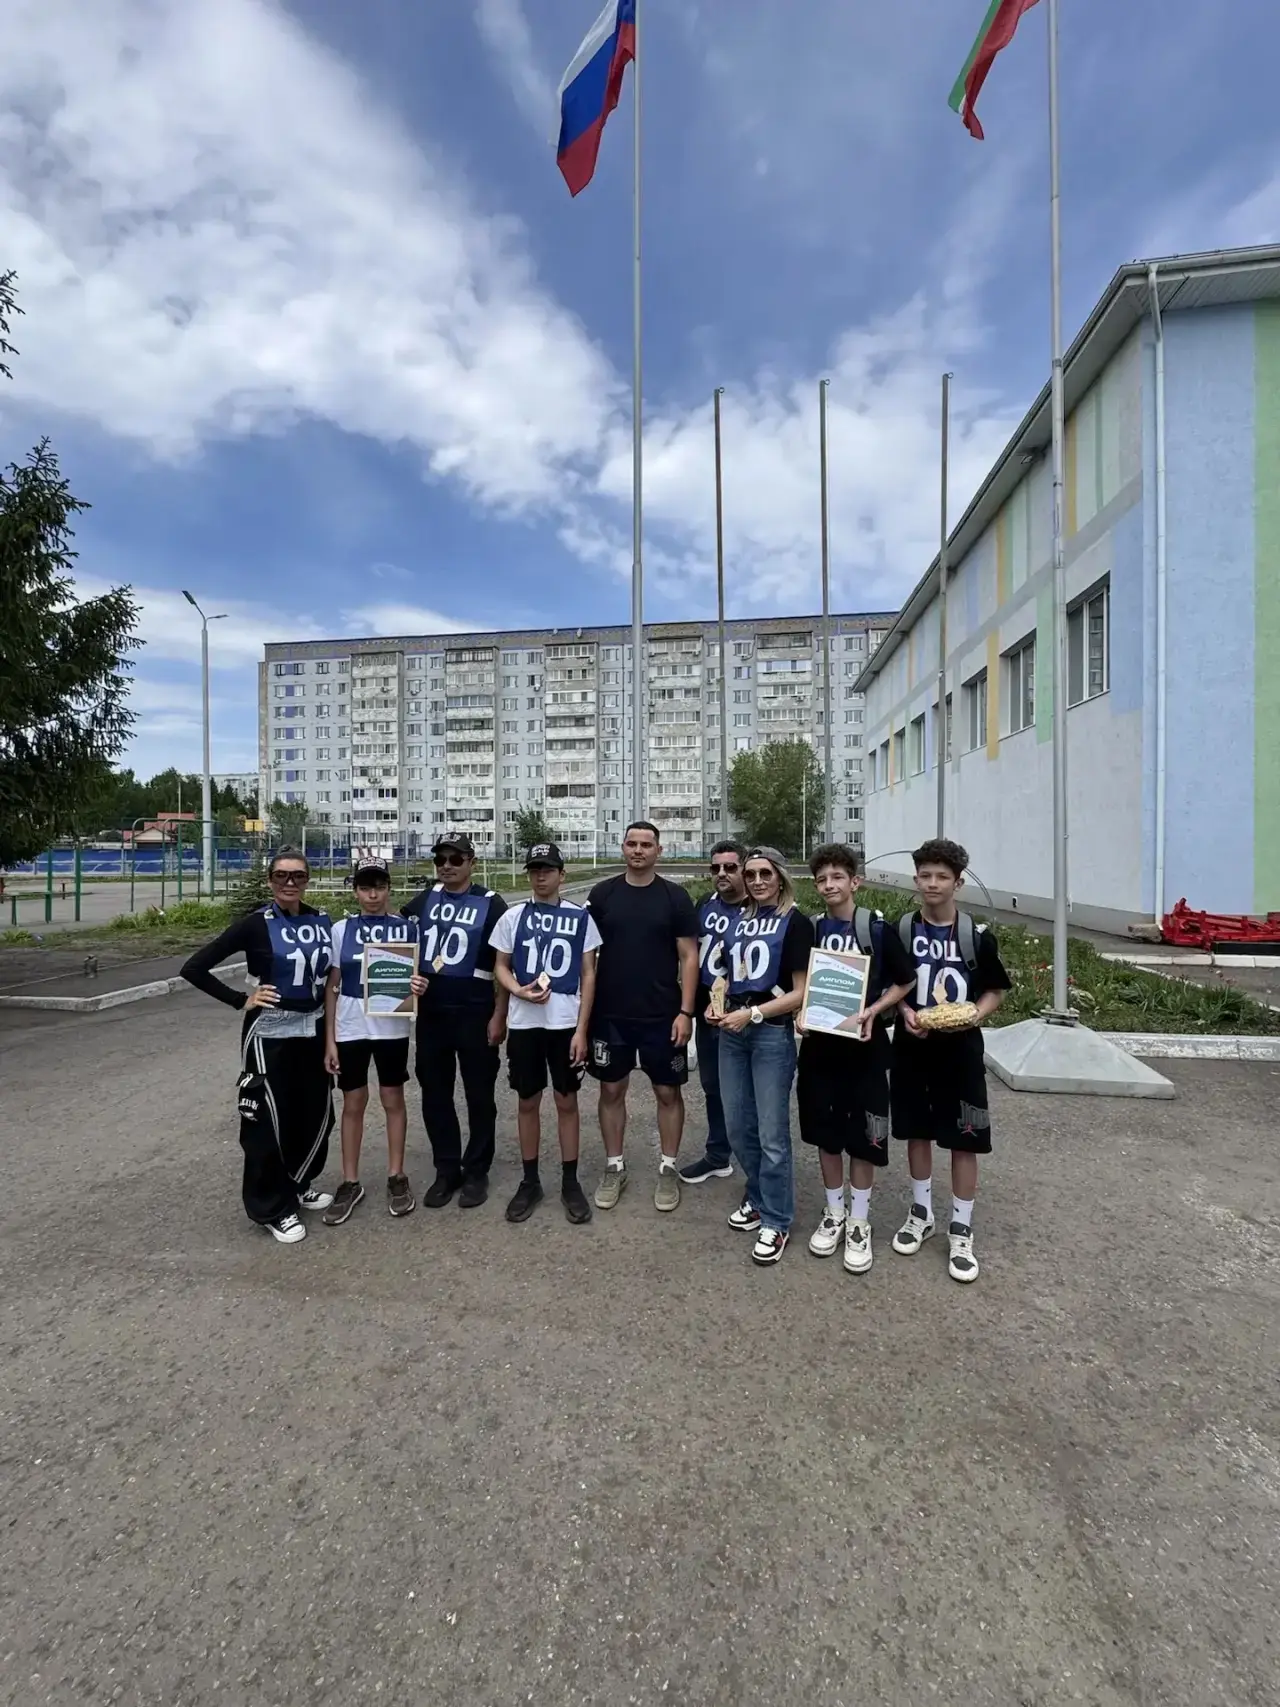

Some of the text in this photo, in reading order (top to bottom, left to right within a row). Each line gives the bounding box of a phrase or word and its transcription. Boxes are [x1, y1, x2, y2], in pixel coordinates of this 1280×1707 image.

[429, 902, 478, 925] СОШ
[525, 911, 579, 936] СОШ
[704, 911, 730, 934] СО
[734, 918, 782, 937] СОШ
[423, 924, 469, 966] 10
[521, 936, 573, 979] 10
[729, 939, 770, 982] 10
[818, 975, 856, 987] ДИПЛОМ
[915, 963, 968, 1006] 10
